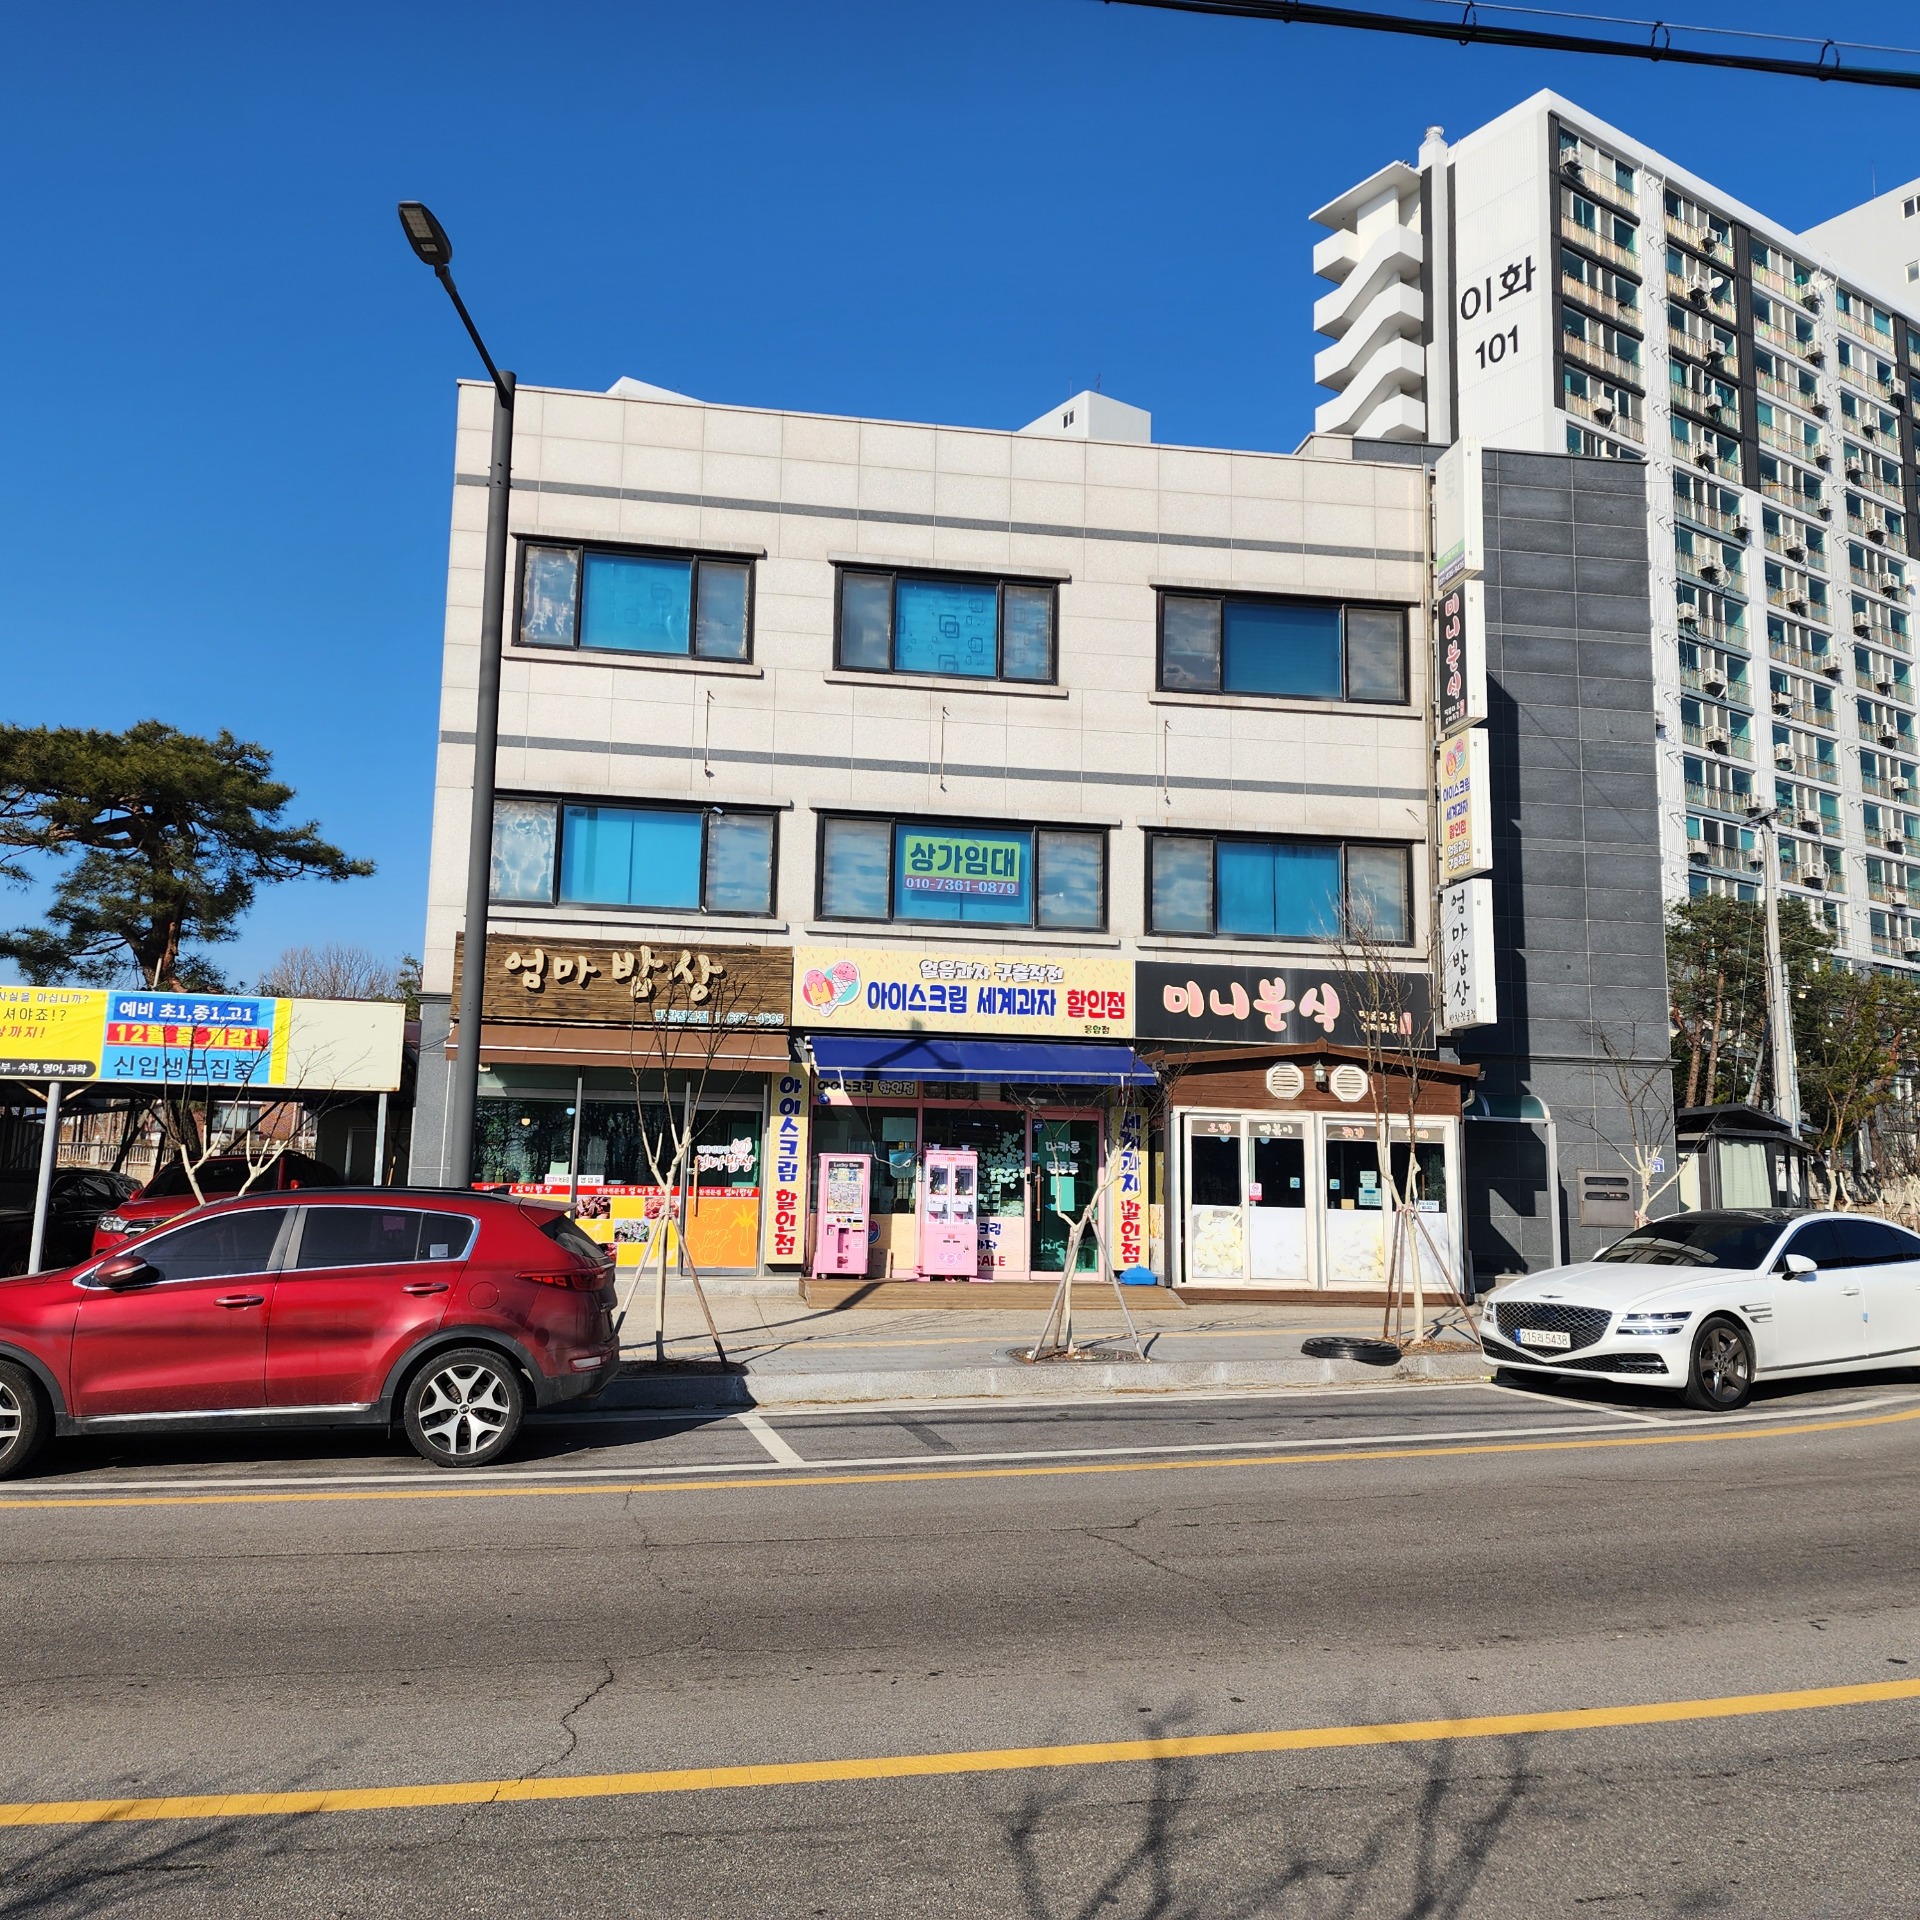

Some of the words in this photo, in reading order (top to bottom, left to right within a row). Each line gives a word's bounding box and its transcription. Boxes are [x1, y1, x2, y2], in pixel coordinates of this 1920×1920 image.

[1461, 255, 1536, 320] 이화
[1475, 324, 1518, 369] 101
[1445, 592, 1461, 699] 미니분식
[1443, 778, 1470, 801] 아이스크림
[1446, 799, 1468, 821] 세계과자
[1449, 820, 1466, 839] 할인점
[911, 843, 1015, 876] 상가임대
[906, 877, 1015, 893] 010-7361-0879
[1451, 889, 1470, 1006] 엄마밥상
[919, 960, 990, 980] 얼음과자
[995, 963, 1064, 983] 구출작전
[37, 993, 89, 1004] 아십니까?
[867, 982, 967, 1014] 아이스크림
[976, 987, 1056, 1016] 세계과자
[1067, 989, 1125, 1019] 할인점
[1163, 977, 1340, 1033] 미니분식
[119, 1001, 153, 1018] 예비
[159, 1004, 253, 1021] 초1,중1,고1
[116, 1025, 165, 1043] 12월
[18, 1062, 41, 1074] 수학,
[43, 1064, 65, 1075] 영어,
[67, 1064, 87, 1074] 과학
[879, 1081, 915, 1095] 할인점
[779, 1076, 802, 1182] 아이스크림
[775, 1189, 797, 1256] 할인점
[1121, 1200, 1141, 1263] 할인점
[1545, 1333, 1568, 1346] 5438
